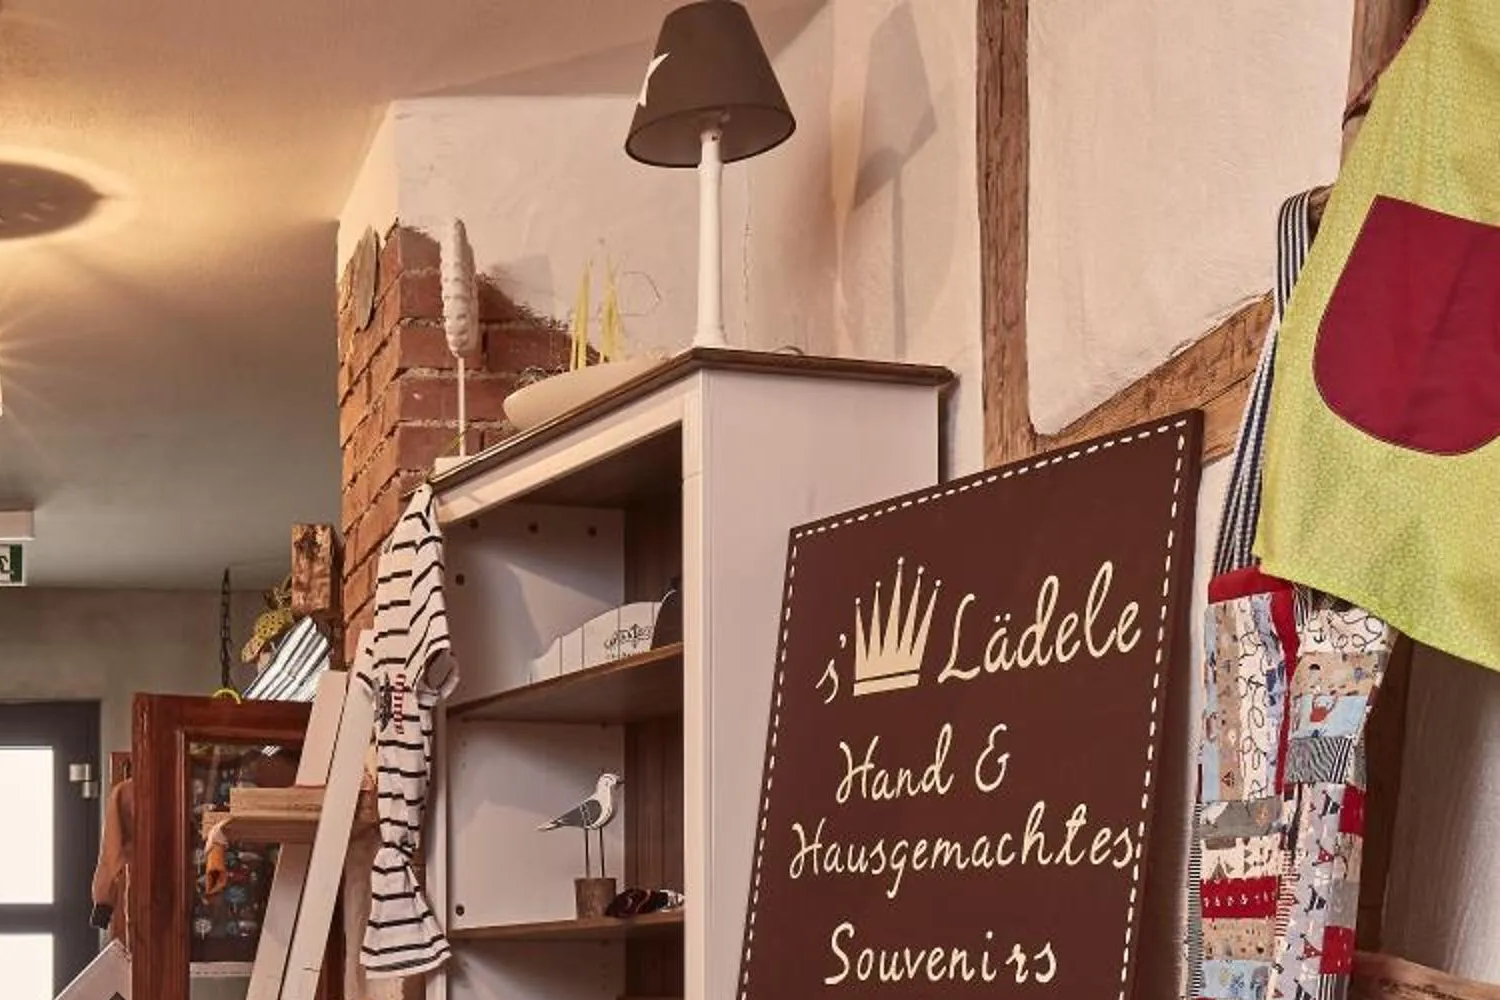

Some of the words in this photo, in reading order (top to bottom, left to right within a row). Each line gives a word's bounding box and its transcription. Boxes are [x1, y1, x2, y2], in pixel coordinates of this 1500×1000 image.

[937, 560, 1142, 685] Lädele
[835, 722, 955, 804] Hand
[974, 722, 1011, 793] &
[788, 800, 1136, 898] Hausgemachtes
[824, 922, 1058, 985] Souvenirs
